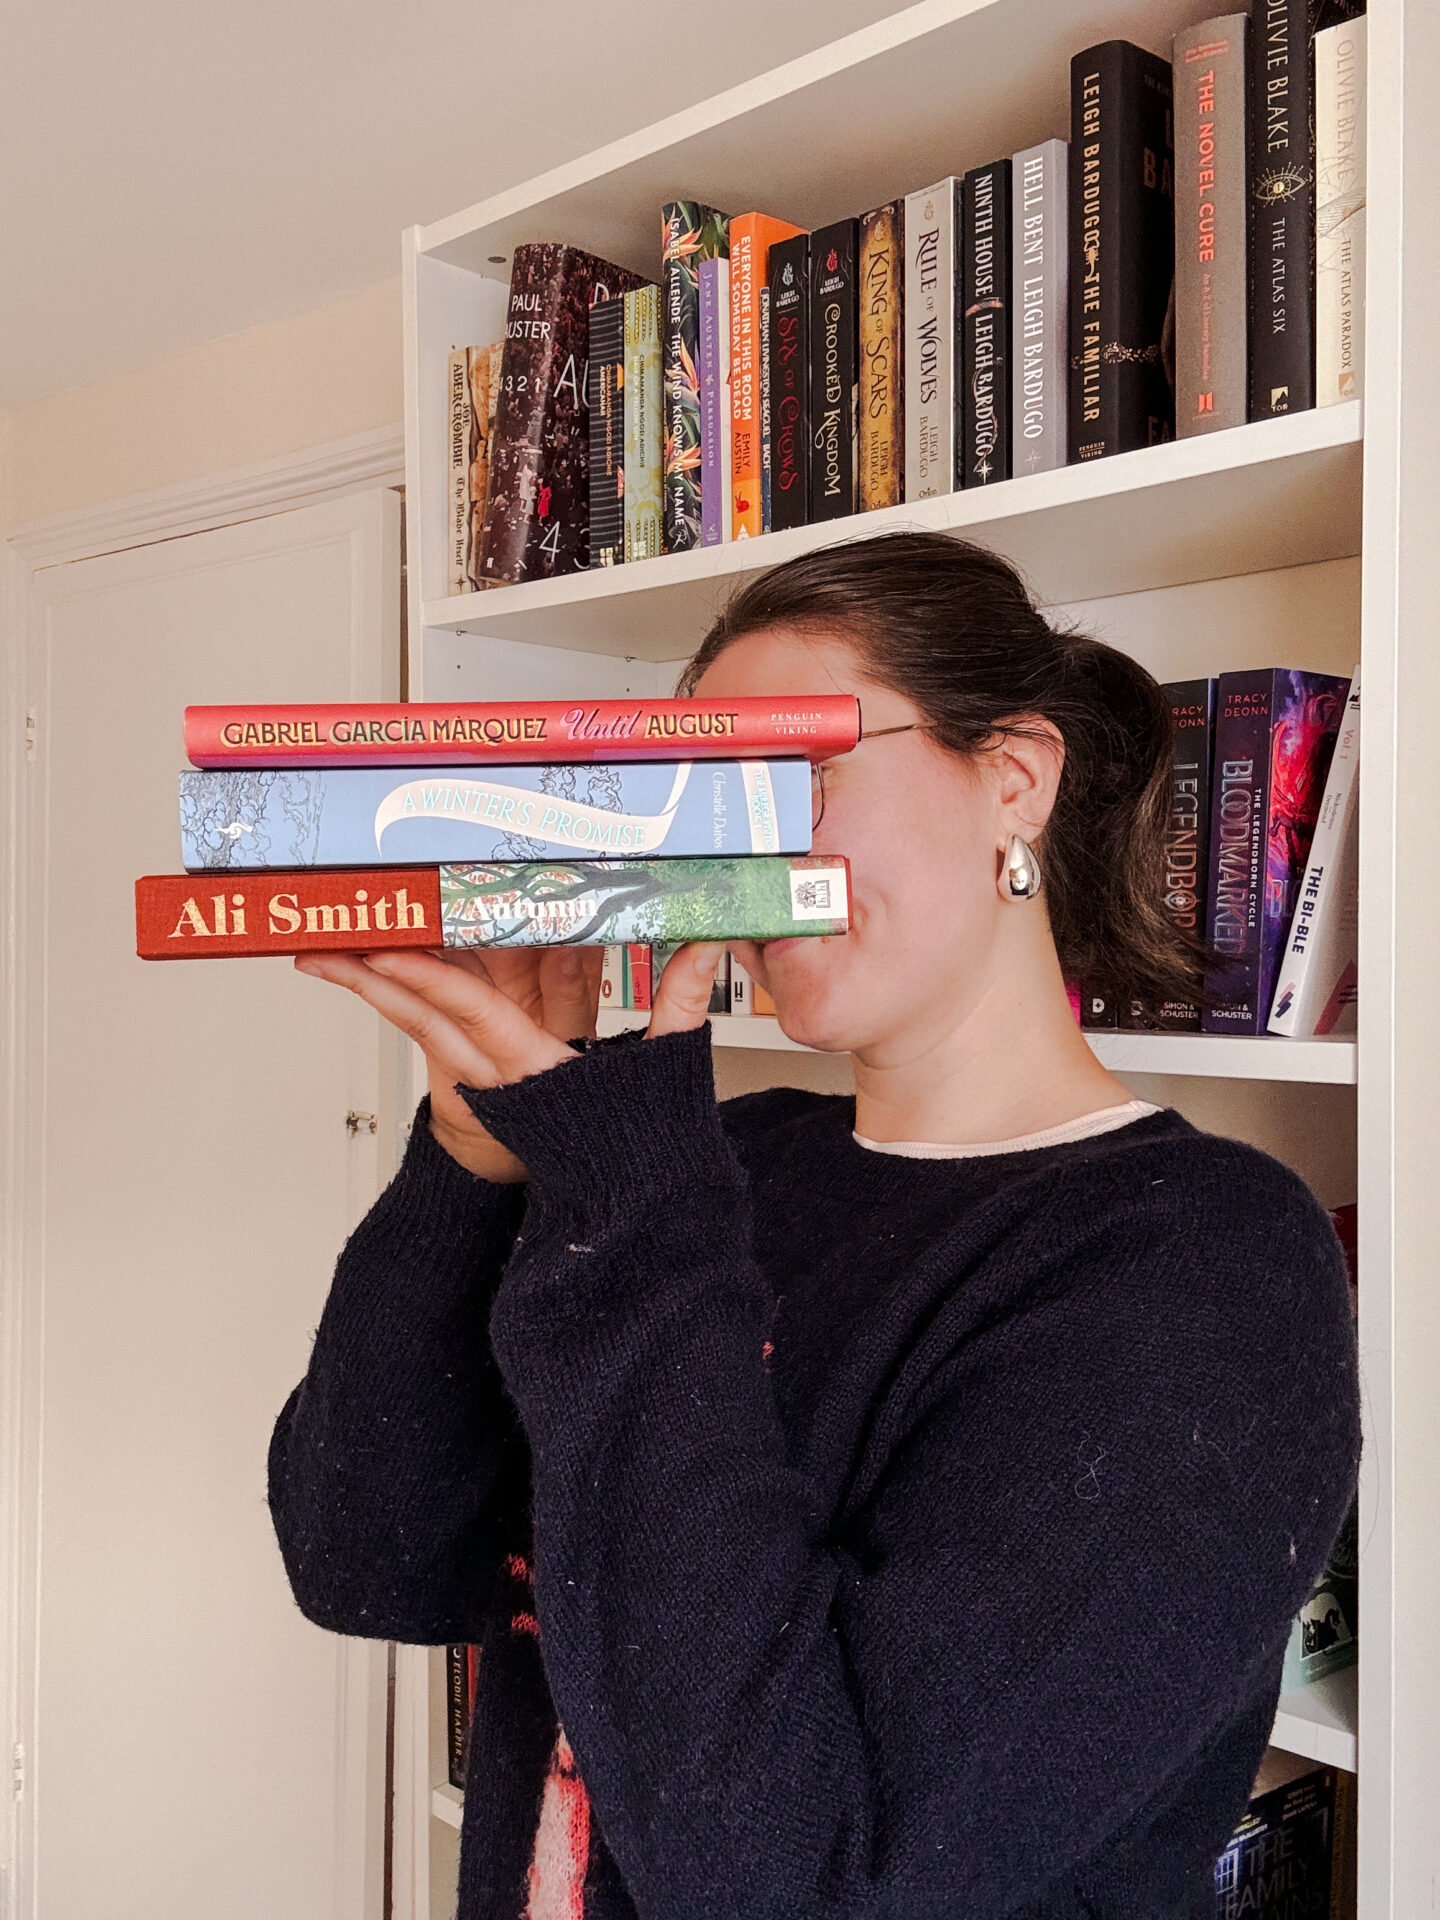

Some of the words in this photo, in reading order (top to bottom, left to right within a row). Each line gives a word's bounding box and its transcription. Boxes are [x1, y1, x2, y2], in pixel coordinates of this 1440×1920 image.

[1198, 69, 1214, 116] THE
[1336, 39, 1355, 111] OLIVIE
[1083, 72, 1100, 137] LEIGH
[1267, 76, 1288, 153] BLAKE
[1198, 122, 1214, 197] NOVEL
[1337, 115, 1355, 180] BLAKE
[975, 173, 993, 234] NINTH
[1024, 155, 1044, 211] HELL
[1083, 143, 1100, 242] BARDUGO
[669, 217, 680, 263] ISABEL
[1024, 213, 1044, 266] BENT
[1198, 203, 1214, 263] CURE
[1272, 217, 1286, 252] THE
[1341, 239, 1352, 264] THE
[731, 242, 740, 280] WILL
[740, 235, 751, 314] EVERYONE
[866, 248, 890, 317] KING
[915, 226, 940, 293] RULE
[975, 235, 993, 298] HOUSE
[1272, 257, 1286, 304] ATLAS
[511, 293, 543, 312] PAUL
[670, 267, 681, 325] ALLENDE
[703, 273, 713, 307] JANE
[1024, 274, 1044, 339] LEIGH
[1083, 272, 1100, 314] THE
[1341, 268, 1352, 307] ATLAS
[732, 282, 742, 354] SOMEDAY
[741, 318, 751, 331] IN
[761, 291, 770, 341] JONATHAN
[1272, 307, 1286, 335] SIX
[671, 332, 681, 358] THE
[705, 315, 713, 368] AUSTEN
[742, 335, 752, 369] THIS
[777, 316, 799, 366] SIX
[824, 303, 842, 403] CROOKED
[916, 316, 943, 405] WOLVES
[975, 313, 994, 369] LEIGH
[1341, 311, 1352, 369] PARADOX
[672, 361, 683, 400] WIND
[732, 357, 742, 376] BE
[866, 336, 890, 419] SCARS
[1083, 321, 1100, 422] FAMILIAR
[732, 377, 742, 419] DEAD
[742, 371, 752, 421] ROOM
[1024, 342, 1044, 439] BARDUGO
[1271, 404, 1289, 412] TOR
[452, 363, 464, 470] ABERCROMBIE
[672, 404, 683, 456] KNOWS
[707, 390, 715, 468] PERSUASION
[975, 372, 994, 457] BARDUGO
[734, 432, 742, 475] AUSTIN
[742, 433, 751, 467] EMILY
[763, 443, 771, 469] BACH
[777, 396, 799, 491] CROWS
[815, 408, 841, 497] KINGDOM
[870, 431, 879, 491] BARDUGO
[880, 440, 889, 476] LEIGH
[919, 416, 929, 478] BARDUGO
[929, 426, 938, 463] LEIGH
[674, 462, 684, 481] MY
[457, 501, 465, 535] Blade
[674, 486, 685, 526] NAME
[770, 711, 824, 722] PENGUIN
[1172, 705, 1204, 716] RACY
[1224, 707, 1268, 718] DEONN
[1227, 693, 1268, 704] TRACY
[220, 722, 328, 748] GABRIEL
[329, 716, 428, 745] GARCÍA
[429, 716, 548, 746] MÁRQUEZ
[559, 708, 643, 740] Until
[643, 712, 740, 739] AUGUST
[774, 725, 818, 735] VIKING
[402, 791, 417, 812] A
[421, 787, 536, 827] WINTER'S
[537, 807, 647, 847] PROMISE
[1254, 787, 1262, 809] THE
[713, 818, 728, 849] Dabos
[1214, 759, 1254, 955] BLOODMARKED
[1251, 814, 1262, 889] LEGENDBORN
[1306, 866, 1324, 898] THE
[168, 893, 249, 938] Ali
[267, 889, 428, 935] Smith
[466, 898, 599, 921] Autumn
[1248, 894, 1256, 929] CYCLE
[1292, 900, 1315, 955] BI-BLE
[1160, 1010, 1199, 1020] SCHUSTER
[1164, 1002, 1188, 1010] SIMON
[1211, 1009, 1252, 1020] SCHUSTER
[453, 1662, 462, 1703] ELODIE
[454, 1709, 462, 1756] HARPER
